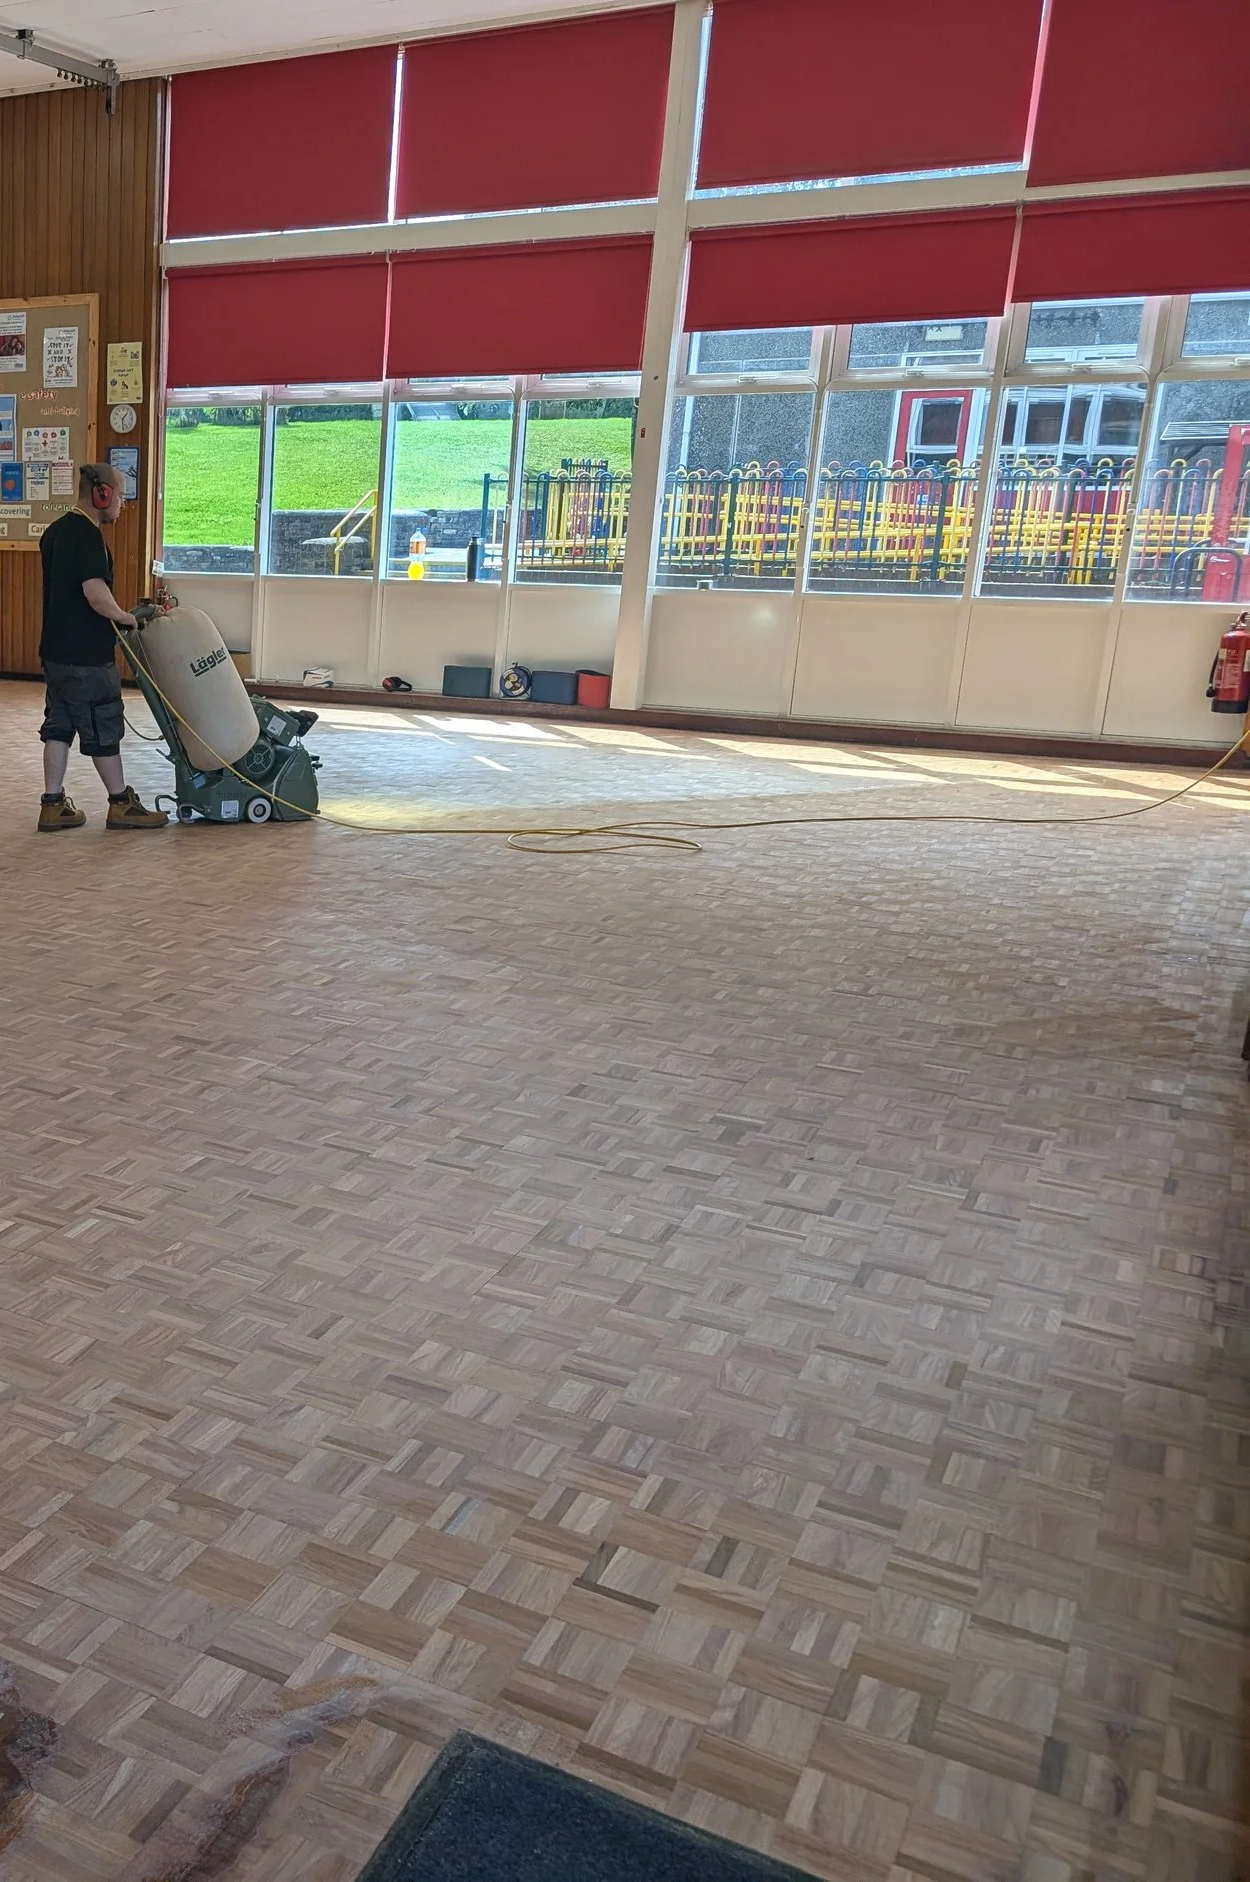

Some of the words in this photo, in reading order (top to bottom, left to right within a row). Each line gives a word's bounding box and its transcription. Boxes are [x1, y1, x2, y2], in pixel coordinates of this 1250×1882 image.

[27, 388, 58, 400] safety
[42, 503, 73, 512] toleranc
[31, 524, 47, 533] Cari
[189, 647, 227, 675] Lägler
